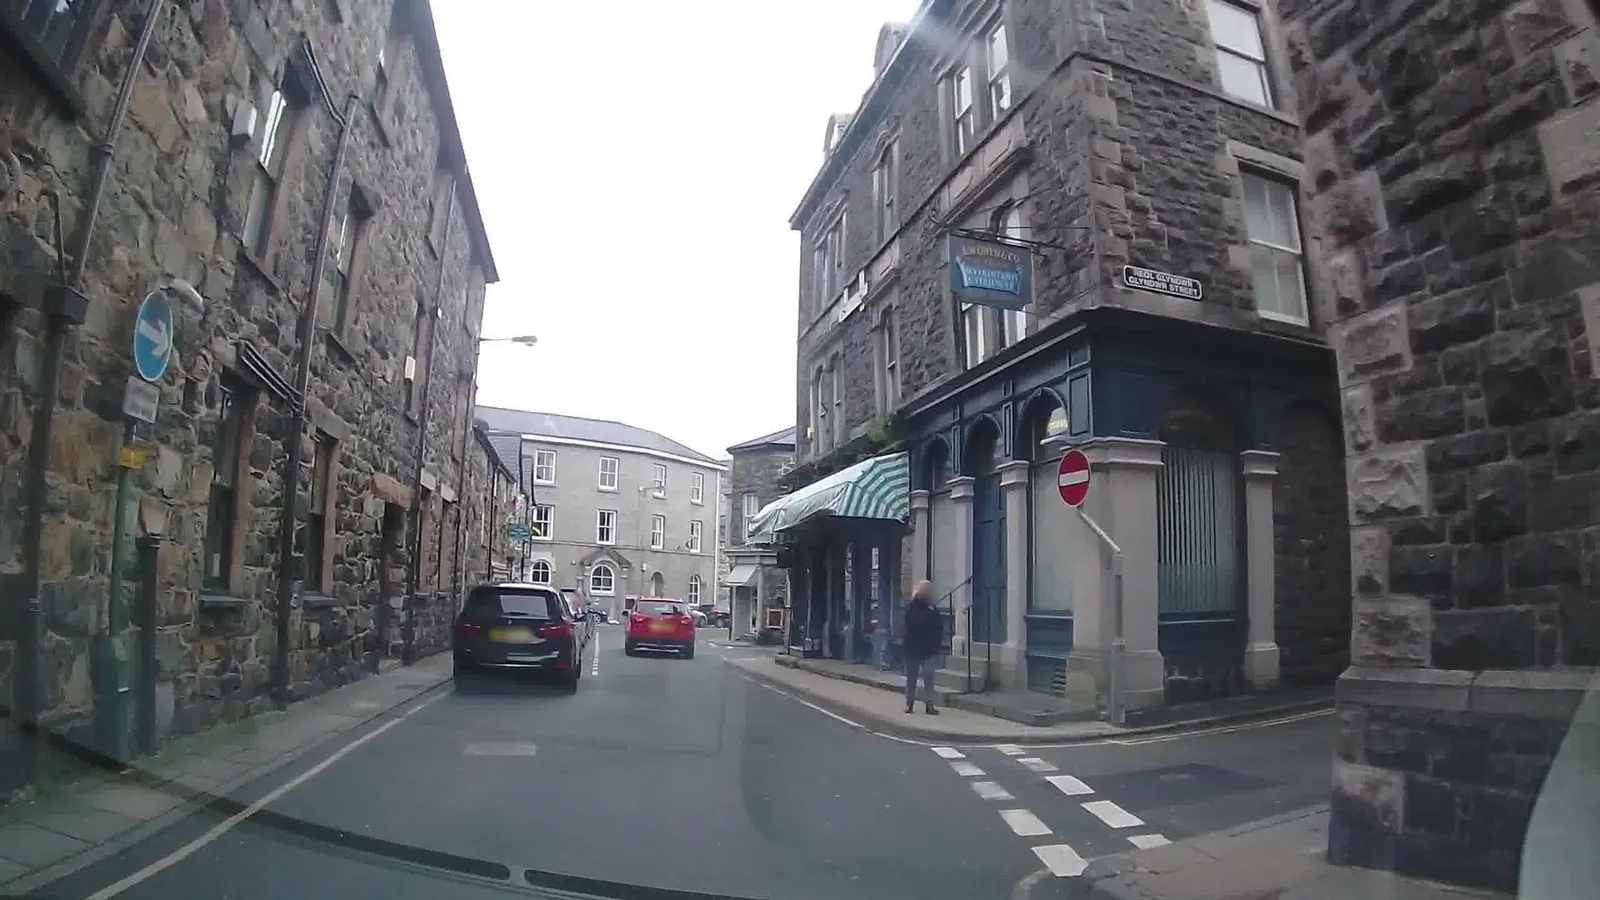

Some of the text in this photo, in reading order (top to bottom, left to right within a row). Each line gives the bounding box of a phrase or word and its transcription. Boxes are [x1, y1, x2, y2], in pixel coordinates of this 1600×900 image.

[1128, 276, 1198, 296] GLYNDWR STREET
[1156, 273, 1193, 287] GLYNDWR
